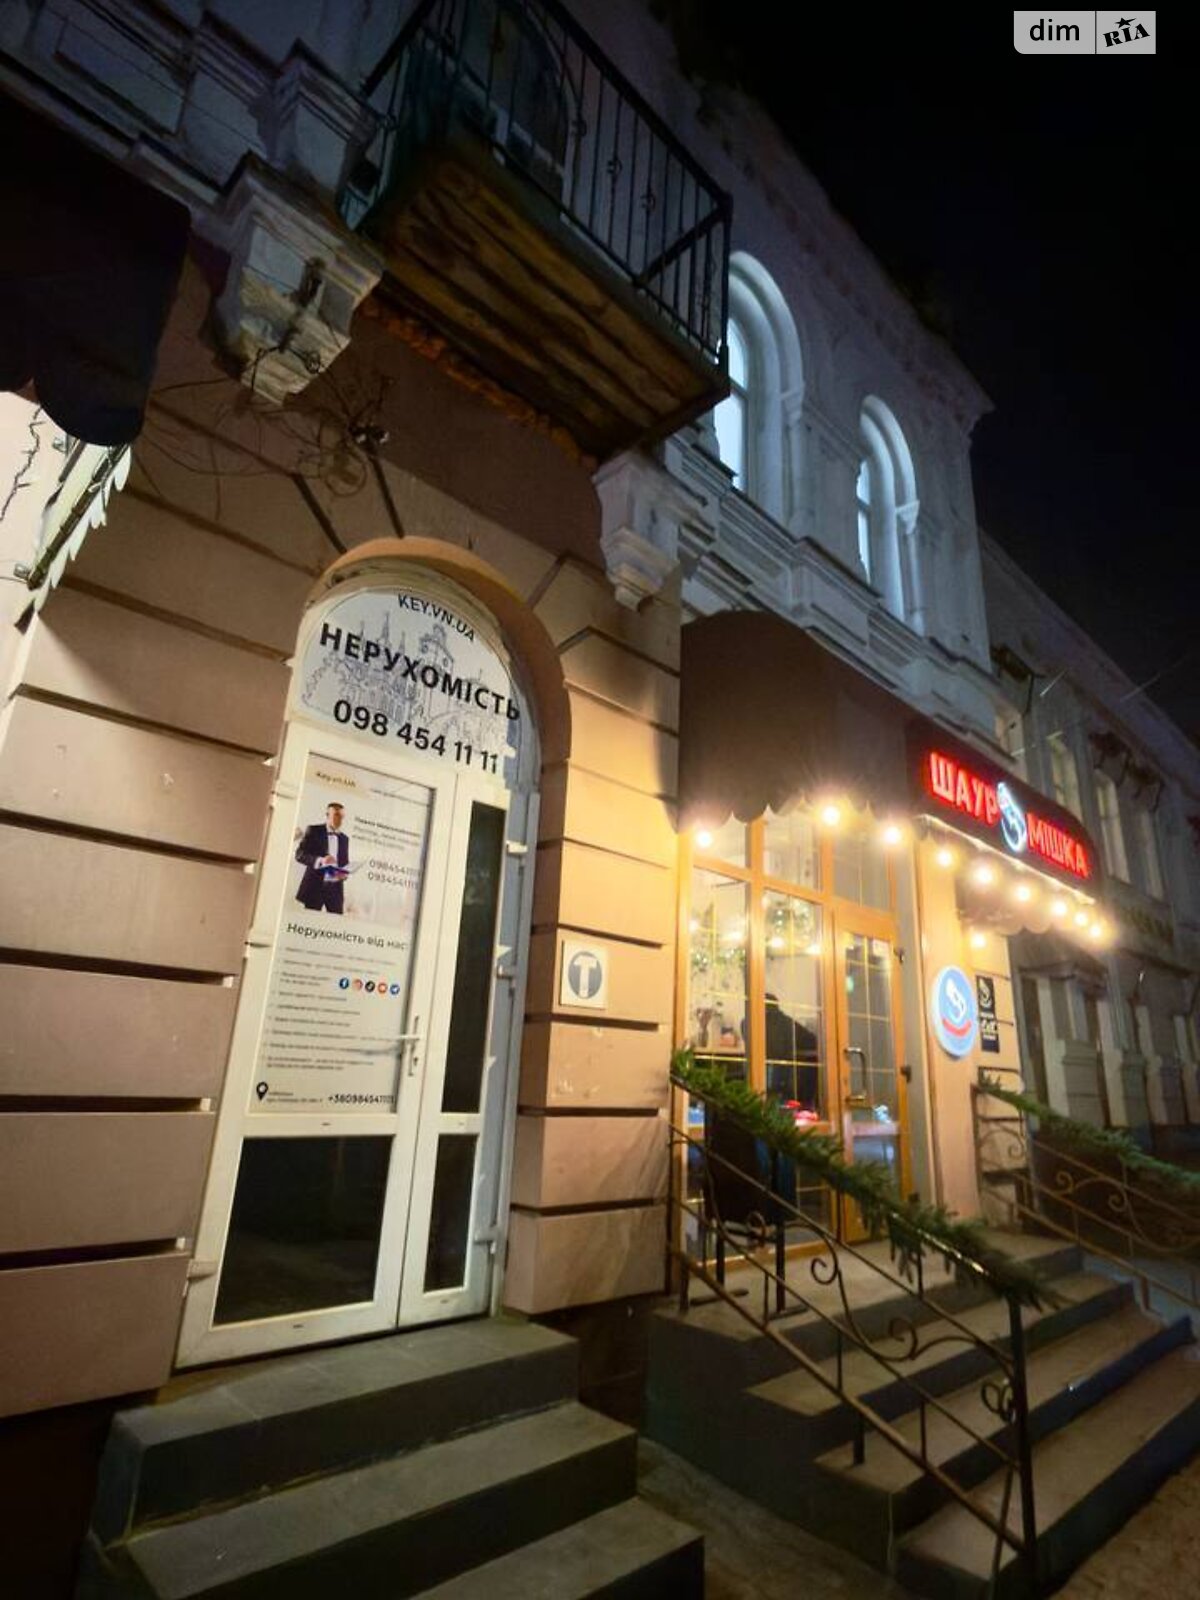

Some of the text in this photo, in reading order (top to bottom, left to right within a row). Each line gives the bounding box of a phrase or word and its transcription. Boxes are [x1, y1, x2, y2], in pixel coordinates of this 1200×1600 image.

[398, 594, 476, 643] KEY.VN.UA
[320, 622, 521, 722] НЕРУХОМІСТЬ
[333, 699, 499, 775] 098 454 11 11
[1026, 812, 1090, 879] МІШКА
[286, 922, 365, 945] Нерухомість
[367, 936, 384, 948] від
